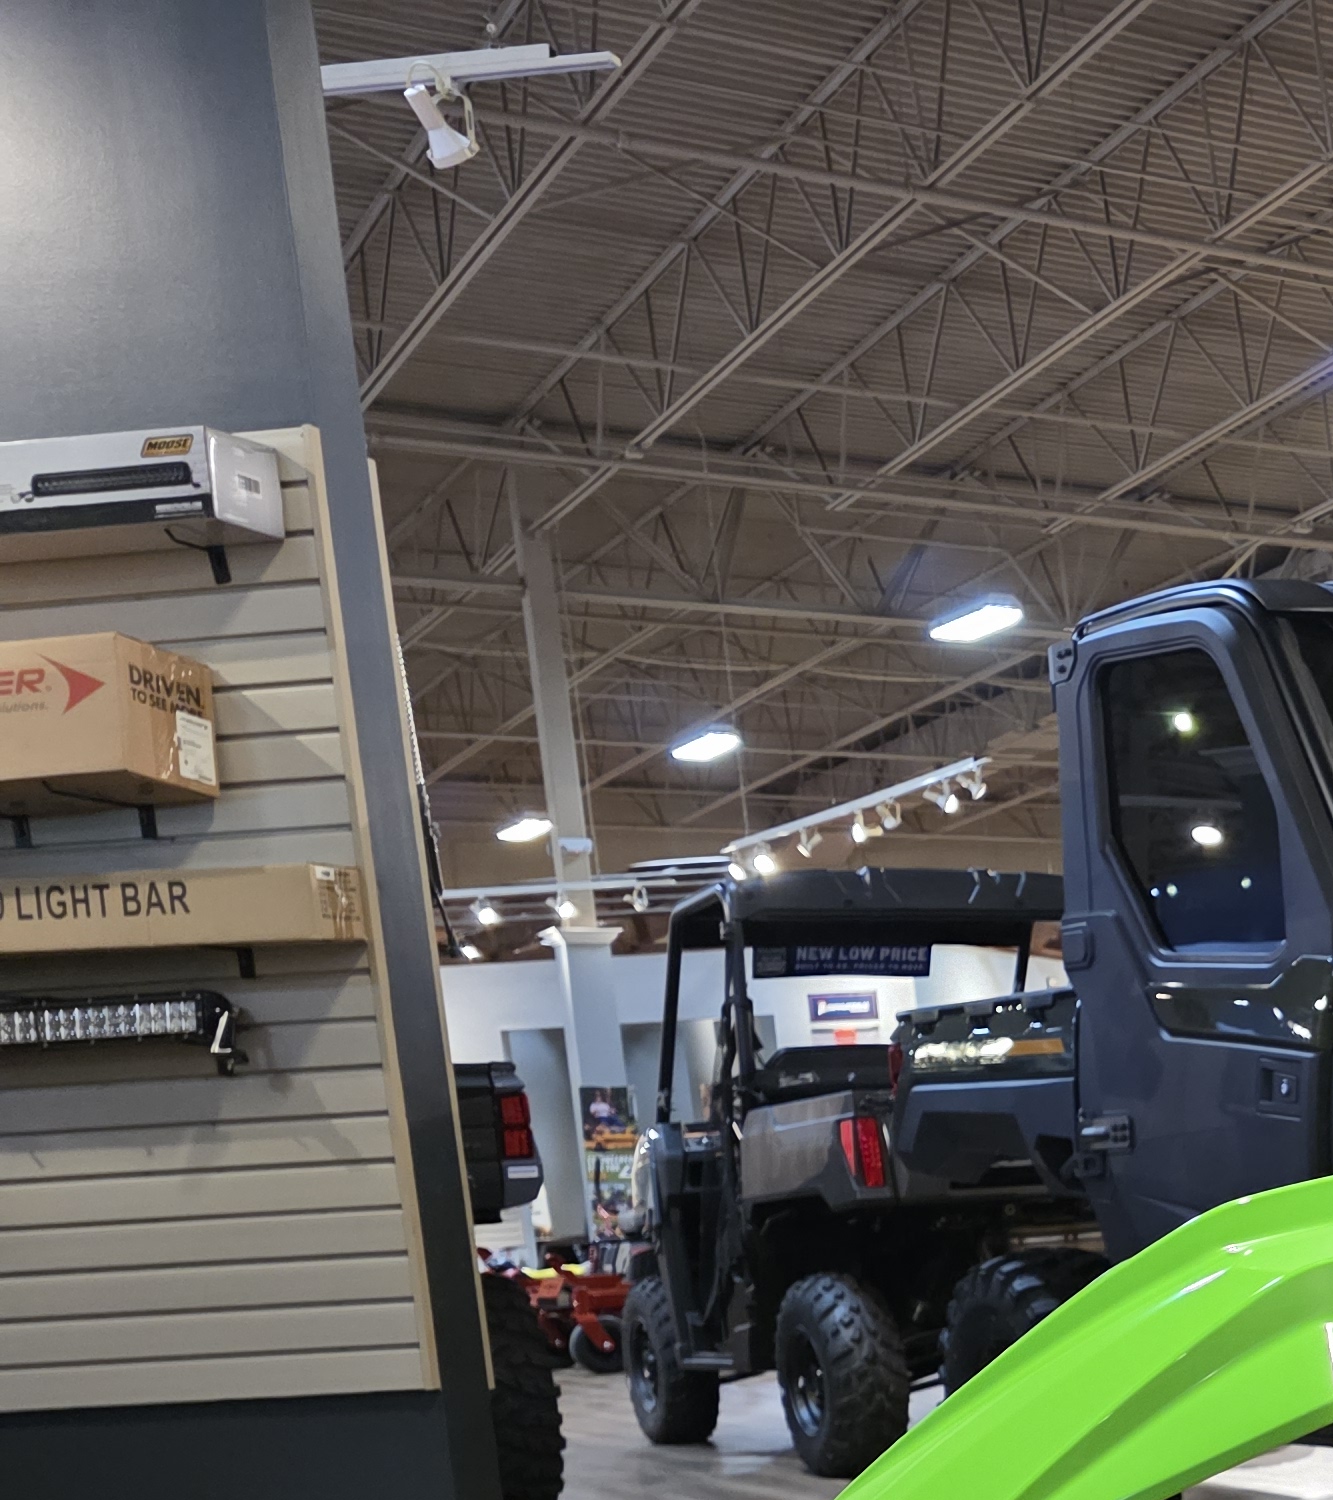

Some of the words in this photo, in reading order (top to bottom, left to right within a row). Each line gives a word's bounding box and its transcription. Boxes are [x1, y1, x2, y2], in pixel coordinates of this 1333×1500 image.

[146, 438, 190, 451] MOOSE
[130, 687, 147, 705] TO
[149, 694, 168, 712] SEE
[15, 884, 111, 921] LIGHT
[120, 880, 191, 918] BAR
[796, 945, 832, 961] NEW
[838, 945, 878, 961] LOW
[879, 945, 928, 962] PRICE
